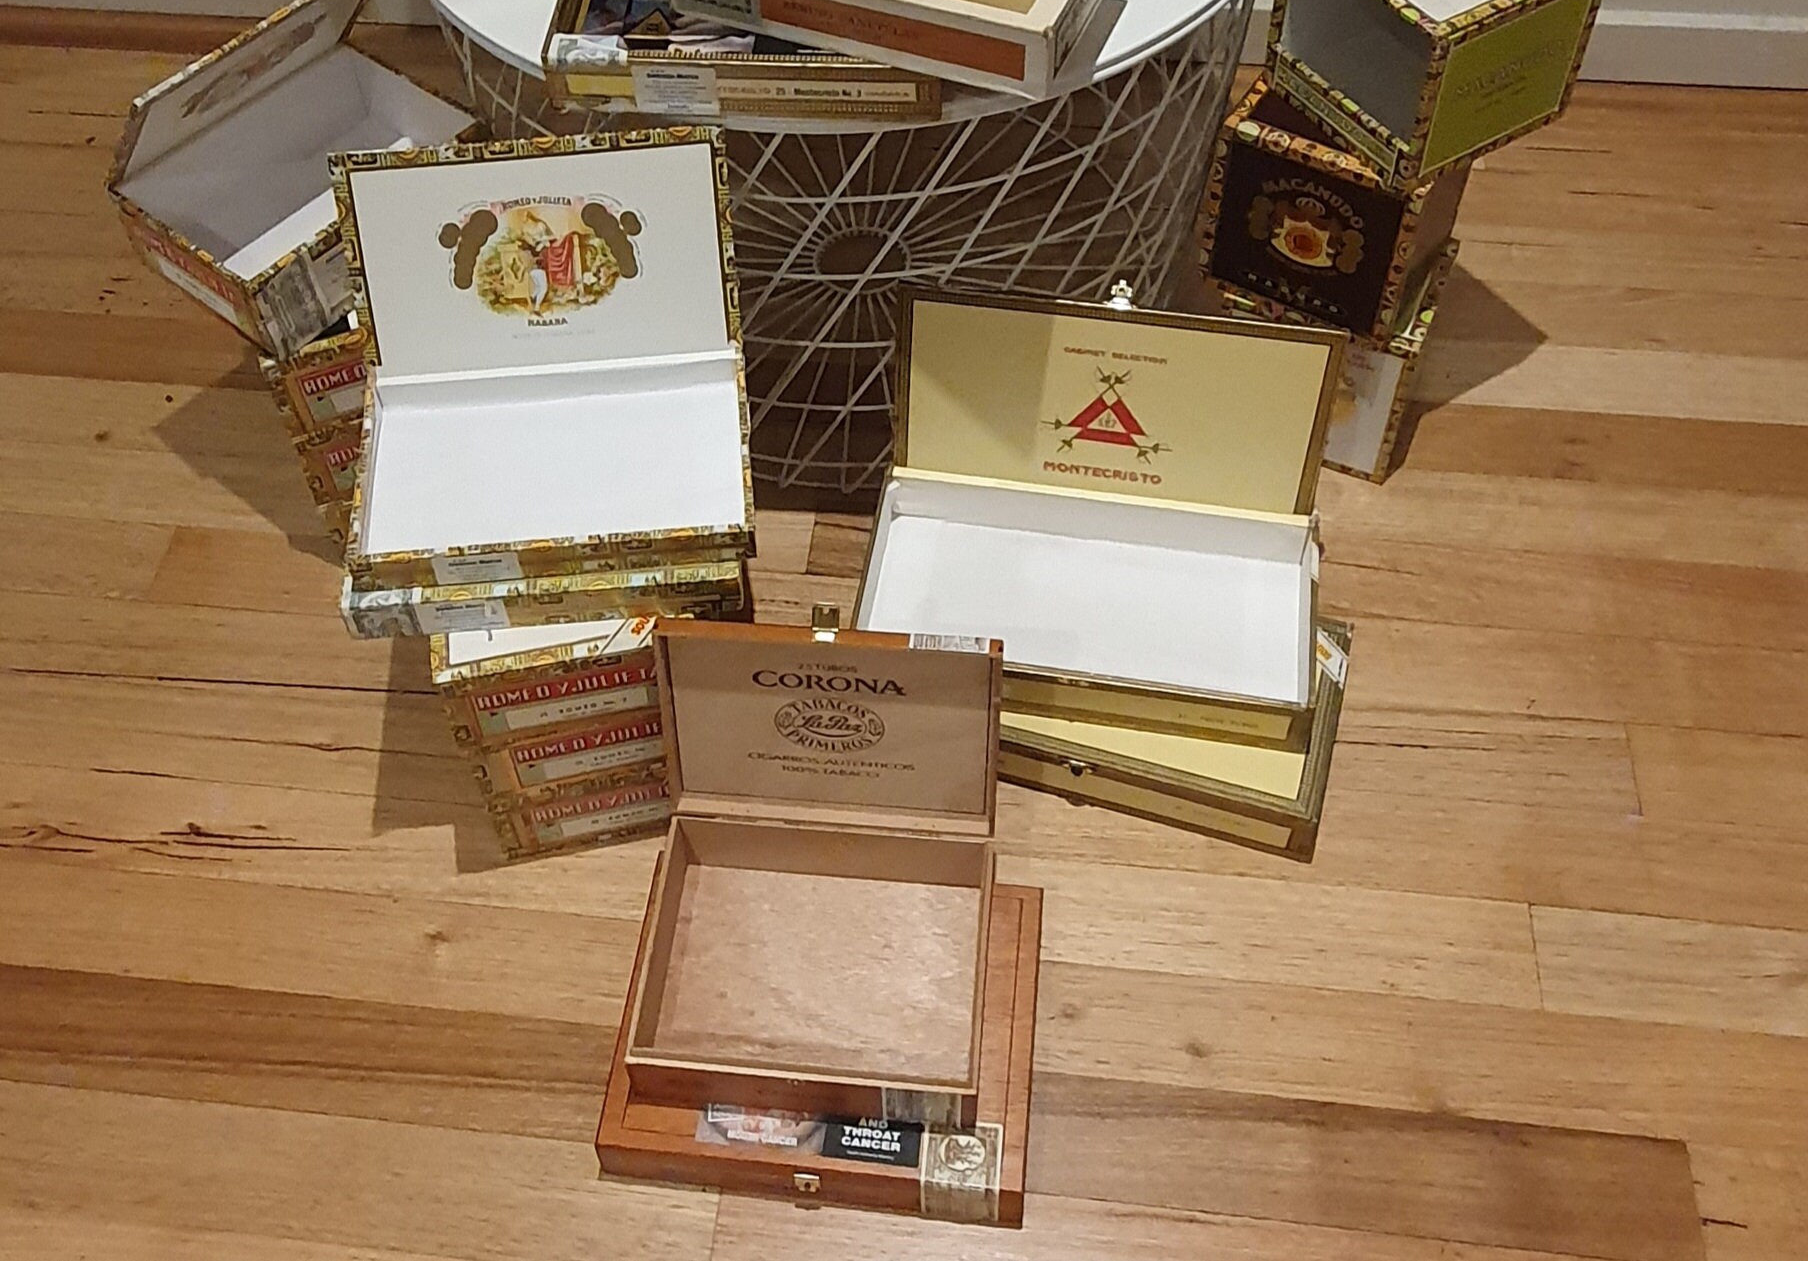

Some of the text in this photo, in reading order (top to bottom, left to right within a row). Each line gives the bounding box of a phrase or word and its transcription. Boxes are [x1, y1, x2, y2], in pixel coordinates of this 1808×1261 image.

[1262, 178, 1364, 229] MACANUDO
[1112, 352, 1168, 364] SELECTION
[304, 364, 367, 394] ROMEO
[1043, 461, 1162, 484] MONTECRISTO
[752, 670, 906, 696] CORONA
[477, 685, 550, 709] ROMEO
[558, 681, 568, 694] Y
[790, 698, 869, 719] TABACOS
[516, 737, 585, 763] ROMEO
[786, 729, 874, 751] PRIMEROS
[747, 751, 819, 765] CIGARROS
[536, 798, 600, 822] ROMEO
[843, 1126, 901, 1142] THROAT
[858, 1117, 889, 1130] AND
[841, 1137, 901, 1153] CANCER
